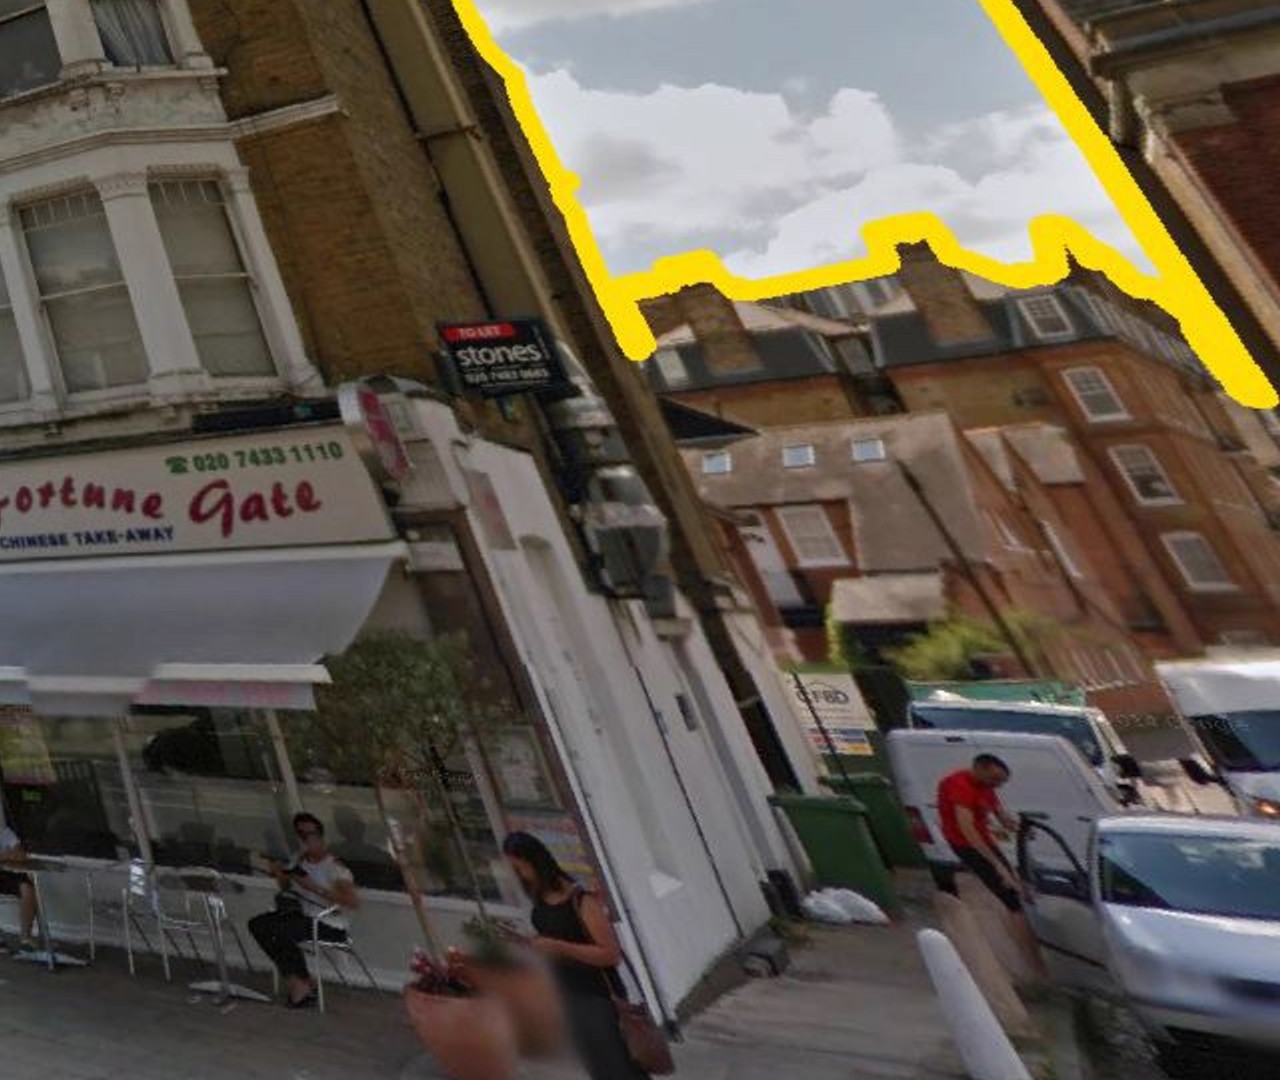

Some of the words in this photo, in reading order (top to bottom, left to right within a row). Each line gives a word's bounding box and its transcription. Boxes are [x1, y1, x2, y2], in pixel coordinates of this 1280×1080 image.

[457, 327, 477, 339] TO
[479, 325, 503, 337] LET
[455, 343, 542, 367] stones
[193, 452, 229, 471] 020
[233, 447, 286, 469] 7433
[290, 441, 343, 463] 1110
[189, 479, 322, 538] Gate
[0, 532, 68, 549] CHINESE
[74, 526, 174, 546] TAKE-AWAY
